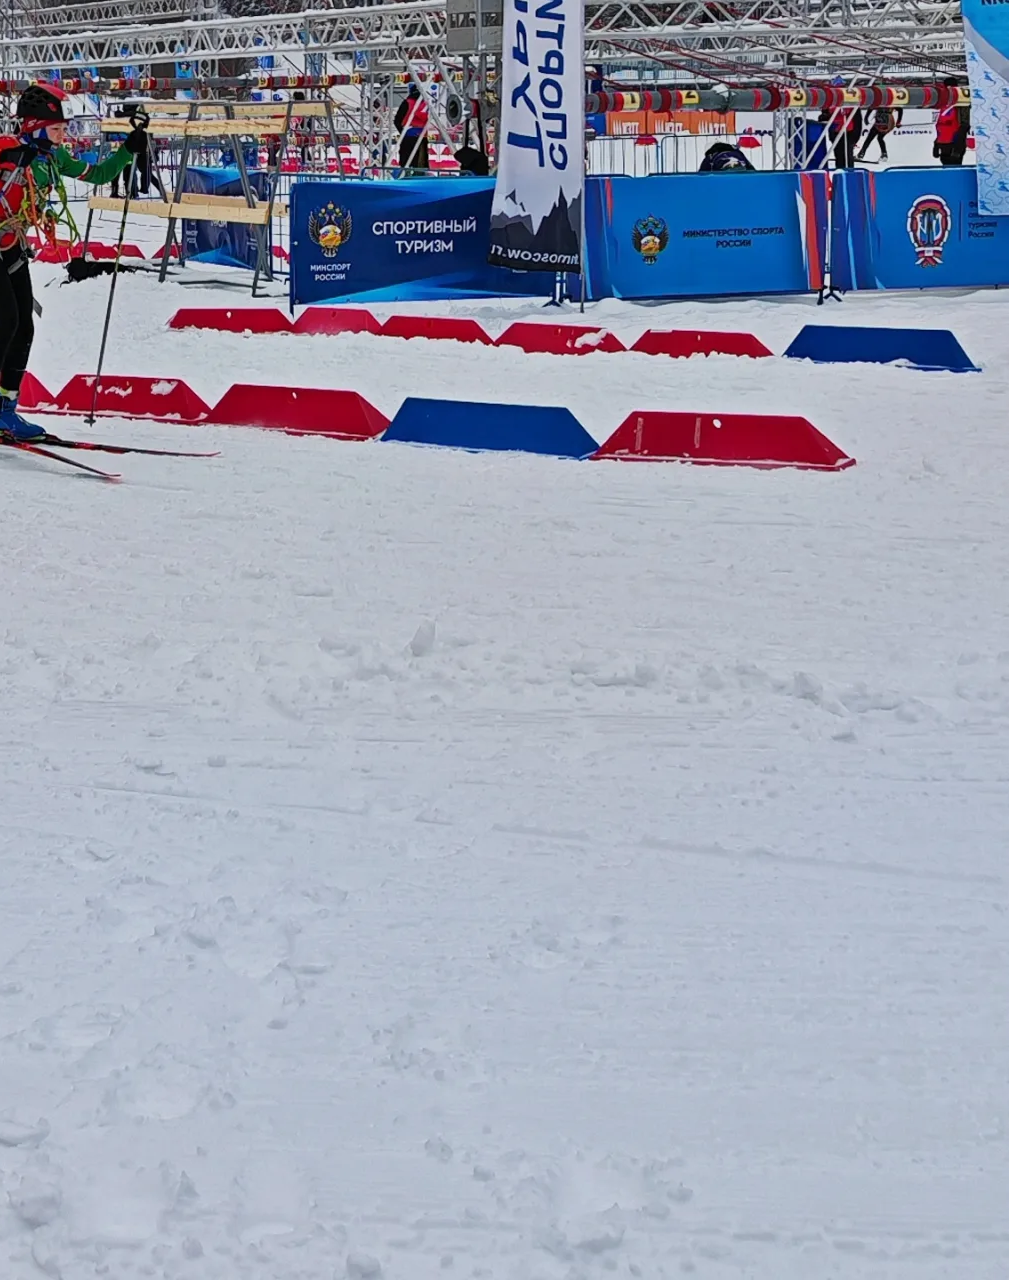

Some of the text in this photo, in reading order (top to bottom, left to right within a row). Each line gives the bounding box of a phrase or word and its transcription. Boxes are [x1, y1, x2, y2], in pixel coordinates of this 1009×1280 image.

[793, 89, 804, 102] 3
[895, 87, 907, 101] 5
[372, 216, 477, 235] СПОРТИВНЫЙ
[682, 226, 785, 238] МИНИСТЕРСТВО СПОРТА
[395, 240, 454, 254] ТУРИЗМ
[715, 239, 752, 248] РОССИИ
[310, 263, 351, 272] МИНСПОРТ
[314, 273, 346, 282] РОССИИ
